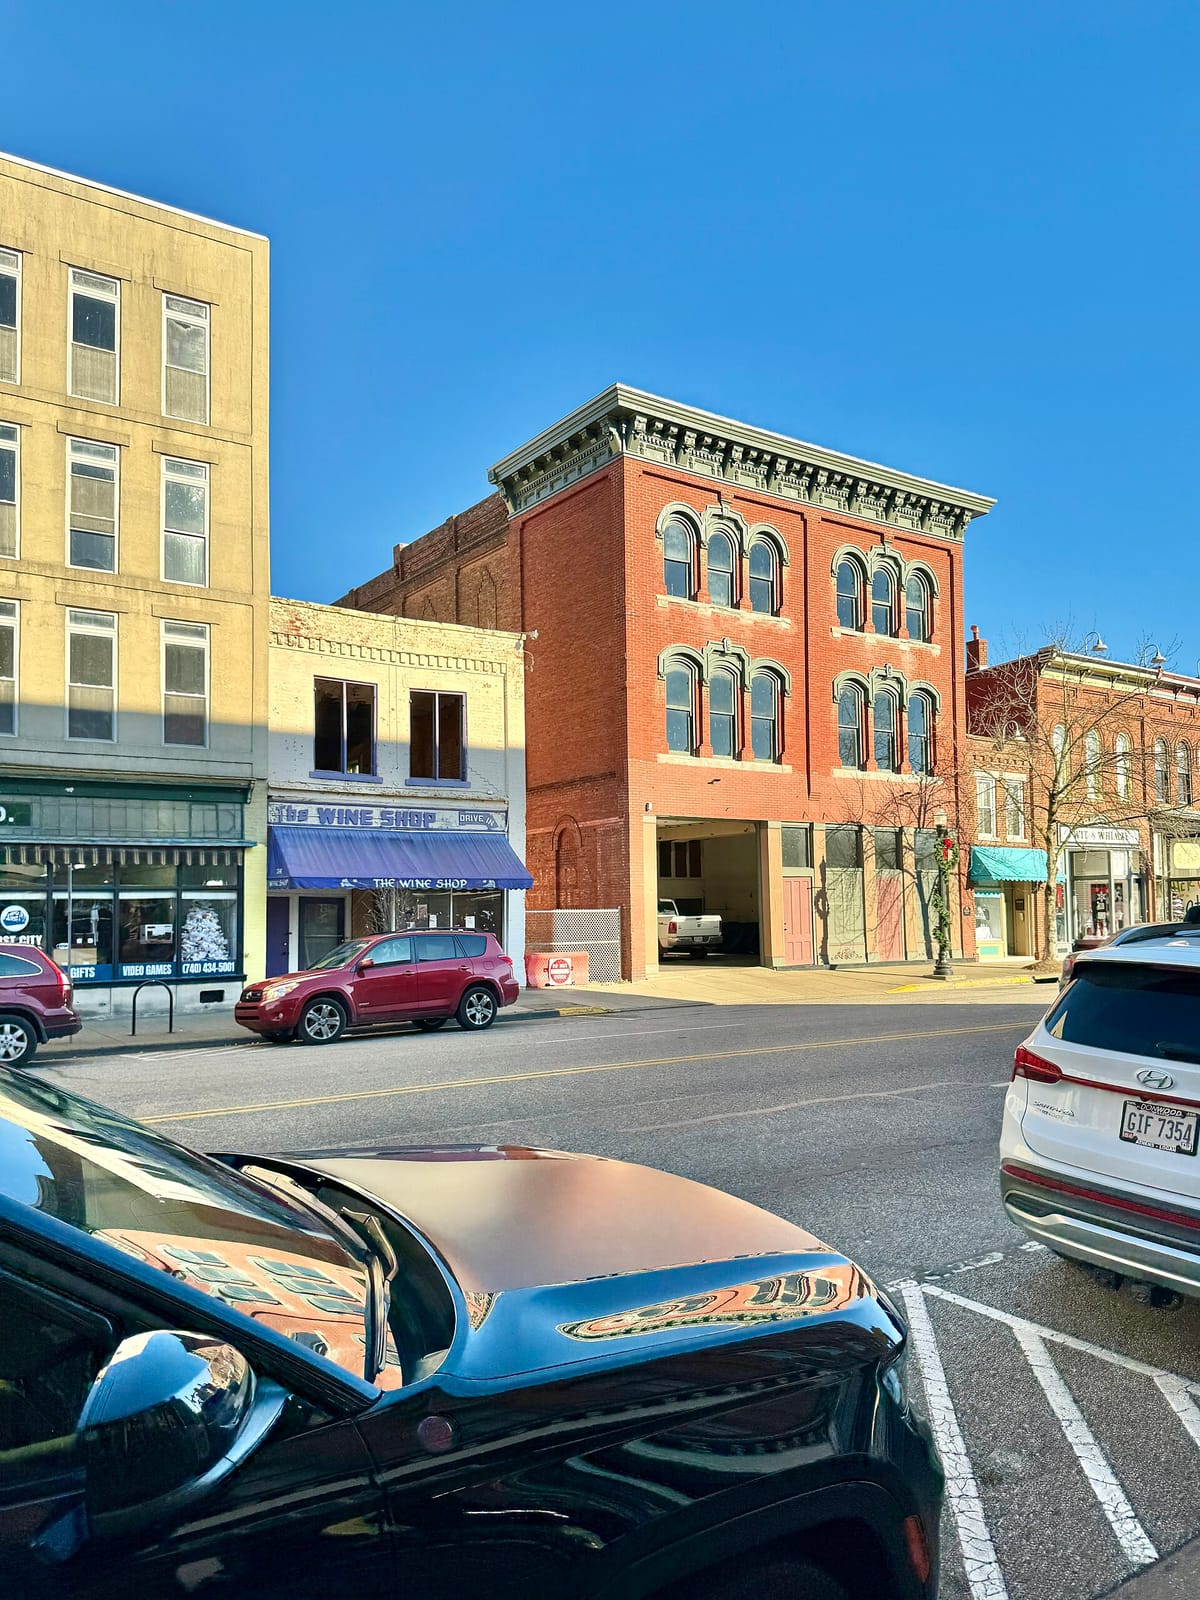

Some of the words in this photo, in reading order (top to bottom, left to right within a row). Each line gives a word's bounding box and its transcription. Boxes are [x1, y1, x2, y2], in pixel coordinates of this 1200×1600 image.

[317, 807, 374, 826] WINE
[381, 810, 436, 828] SHOP
[460, 814, 484, 823] DRIVE
[373, 878, 396, 888] THE
[399, 879, 432, 889] WINE
[435, 879, 468, 889] SHOP
[18, 934, 43, 945] CITY
[70, 967, 96, 978] GIFTS
[122, 965, 145, 976] VIDEO
[145, 964, 172, 975] GAMES
[182, 964, 202, 974] (740)
[202, 962, 235, 973] 434-5001
[1127, 1112, 1154, 1135] GIF
[1158, 1117, 1192, 1144] 7354
